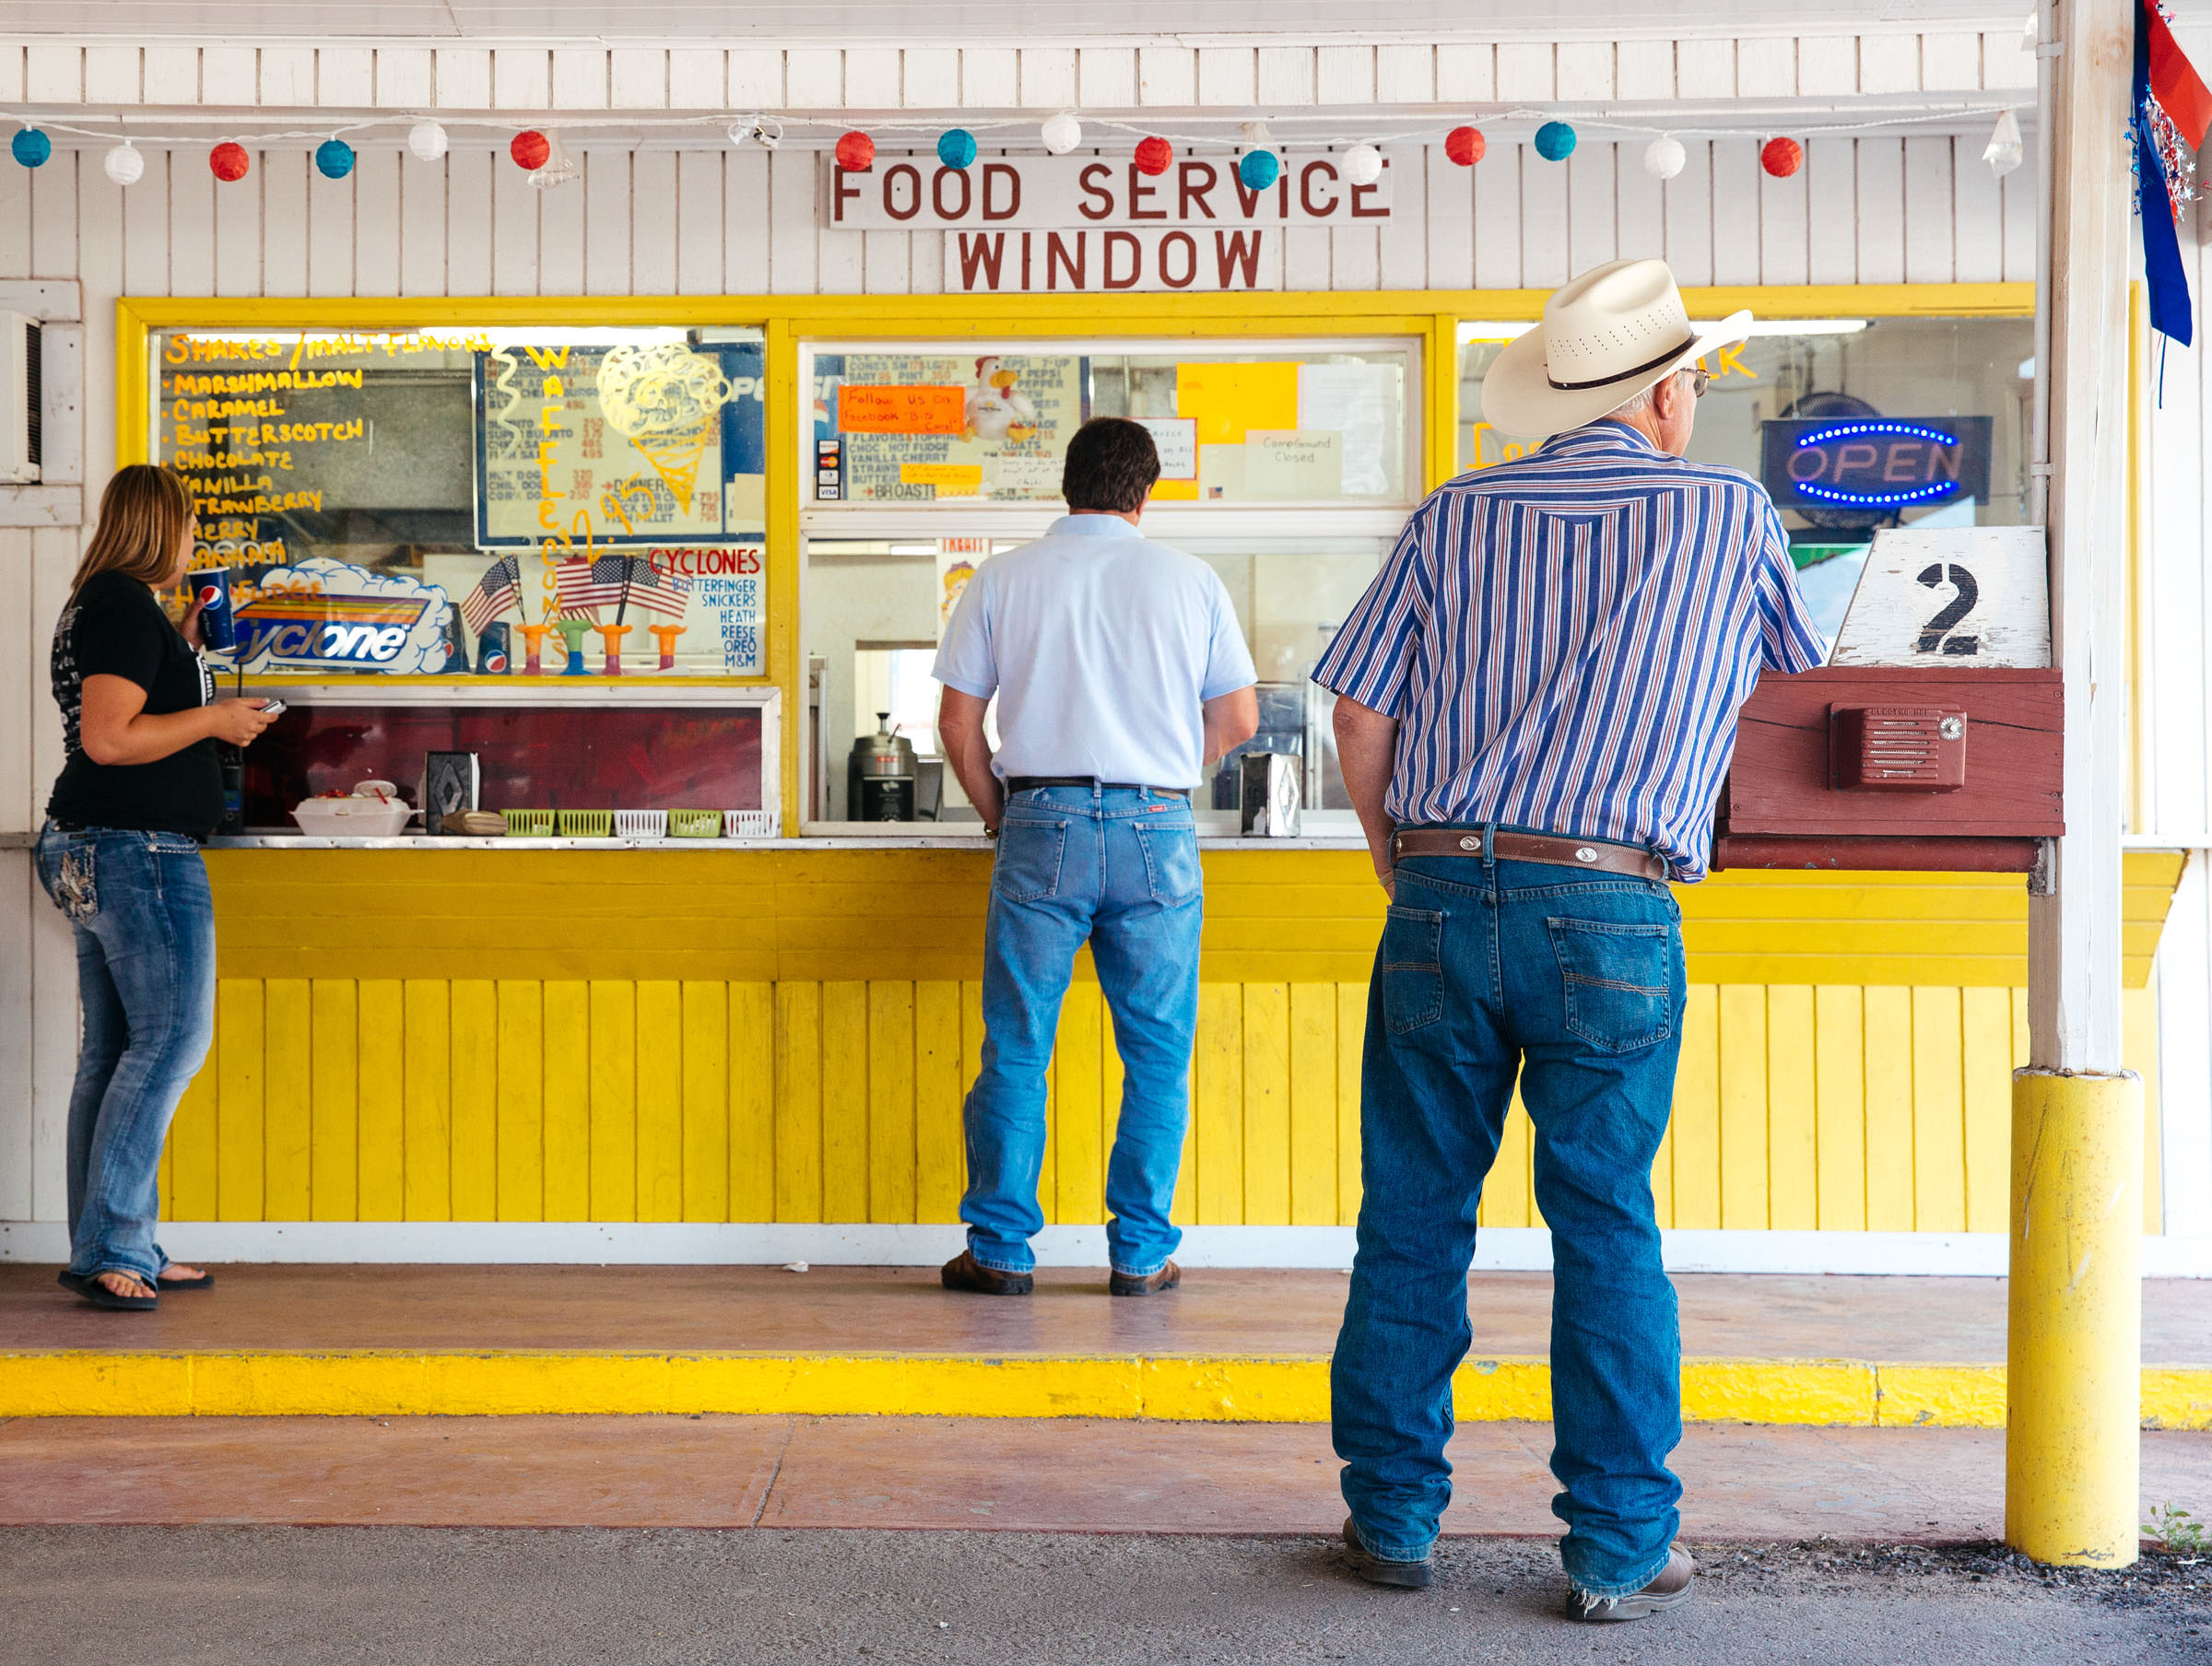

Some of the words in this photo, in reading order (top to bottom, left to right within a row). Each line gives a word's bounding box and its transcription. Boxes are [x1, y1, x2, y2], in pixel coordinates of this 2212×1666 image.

[834, 163, 1021, 221] FOOD
[1077, 159, 1391, 220] SERVICE
[959, 229, 1263, 290] WINDOW
[166, 333, 282, 365] SHAKES
[174, 369, 363, 395] MARSHMALLOW
[172, 398, 286, 421] CARAMEL
[175, 417, 363, 446] BUTTERSCOTCH
[174, 450, 295, 471] CHOCOLATE
[1786, 442, 1964, 483] OPEN
[193, 489, 323, 516] TRAWBERRY
[649, 548, 760, 575] CYCLONES
[673, 577, 757, 592] BUTTERFINGER
[702, 593, 757, 607] SNICKERS
[1916, 563, 1979, 655] 2
[720, 609, 756, 624] HEATH
[722, 626, 756, 641] REESE
[724, 639, 757, 653] OREO
[724, 654, 756, 667] M&M
